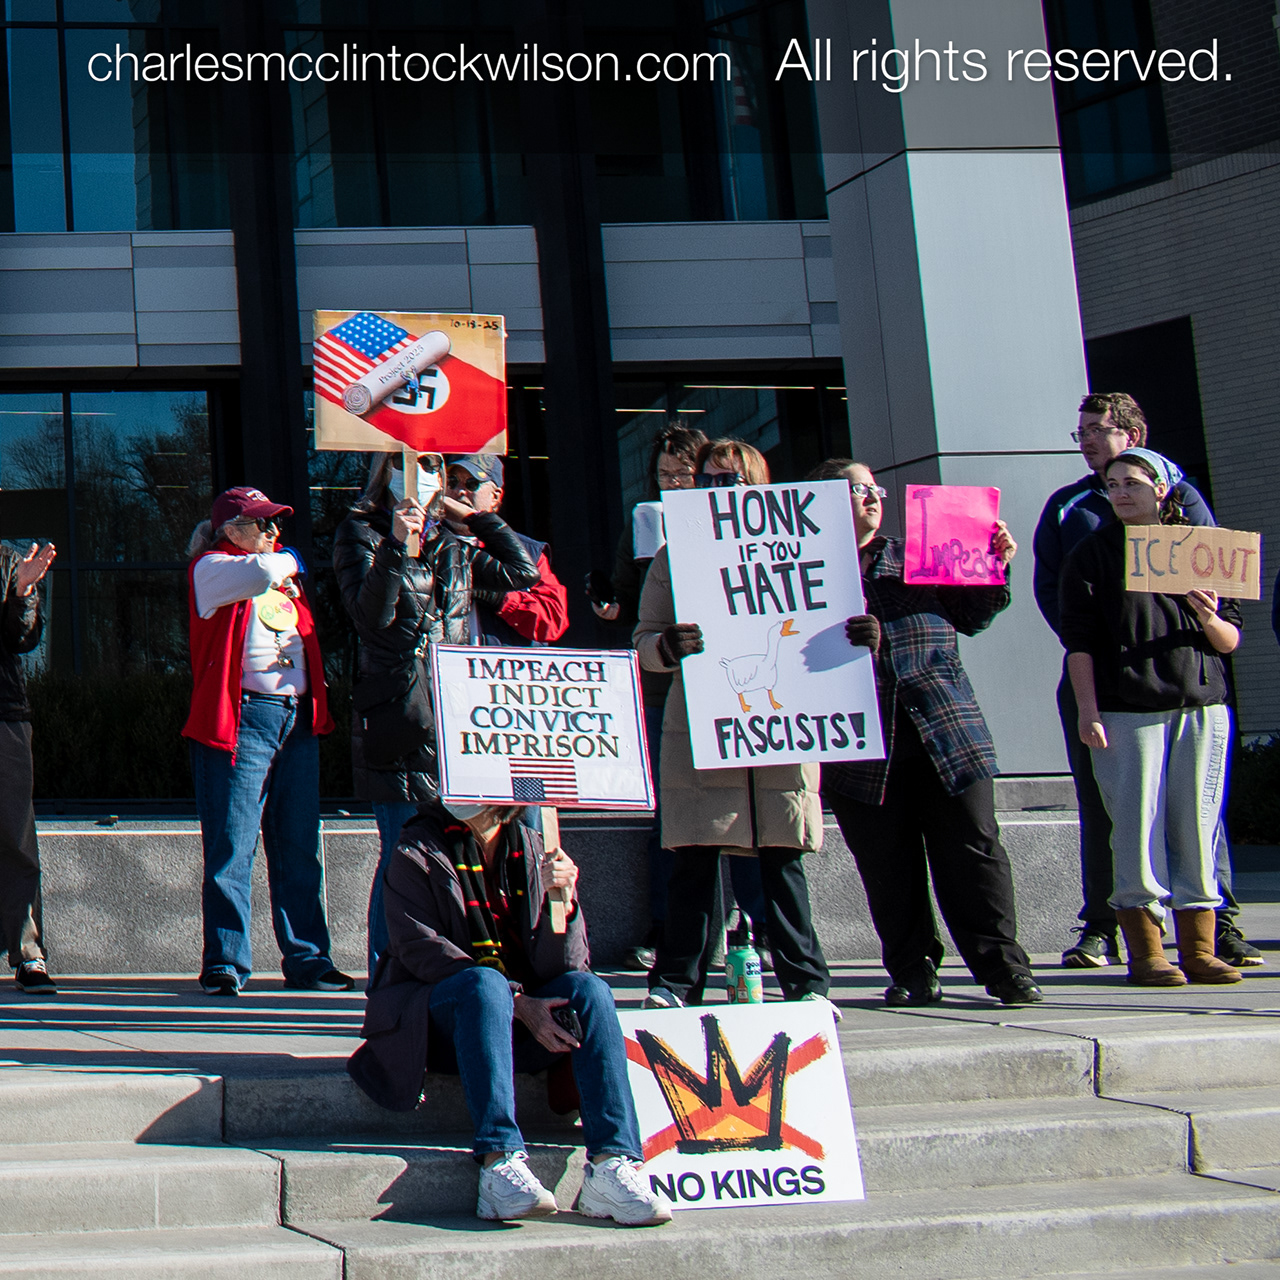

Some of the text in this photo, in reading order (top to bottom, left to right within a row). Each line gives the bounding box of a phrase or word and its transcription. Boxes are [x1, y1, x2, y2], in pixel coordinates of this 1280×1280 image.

[378, 362, 405, 384] Project
[707, 488, 821, 540] HONK
[738, 541, 802, 562] IF YOU
[1128, 536, 1256, 582] ICE OUT
[720, 560, 827, 615] HATE
[466, 657, 608, 682] IMPEACH
[488, 683, 602, 708] INDICT
[470, 706, 613, 734] CONVICT
[460, 730, 619, 758] IMPRISON
[713, 711, 866, 760] FASCISTS!
[649, 1165, 826, 1202] NO KINGS
